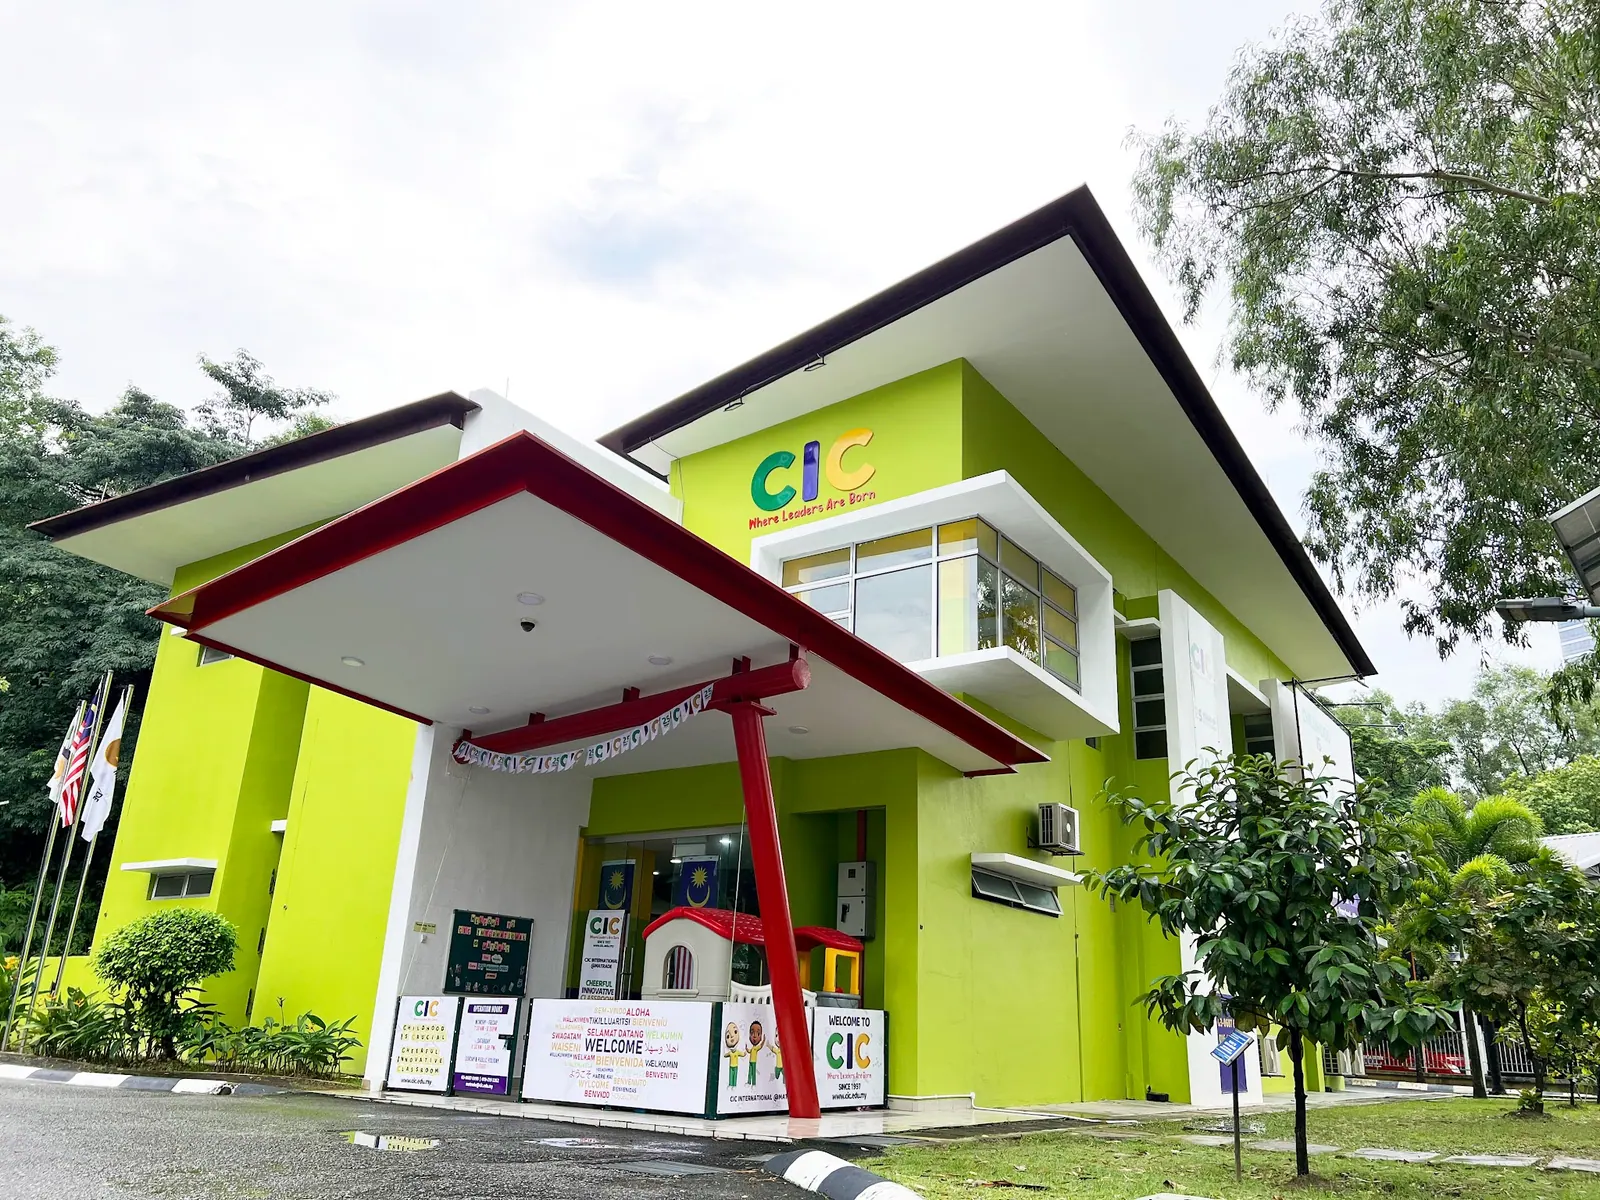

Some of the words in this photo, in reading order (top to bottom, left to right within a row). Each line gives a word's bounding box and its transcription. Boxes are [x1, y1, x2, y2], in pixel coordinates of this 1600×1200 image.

[751, 427, 876, 511] CIC
[748, 514, 780, 530] Where
[782, 504, 824, 522] Leaders
[826, 498, 846, 511] Are
[849, 491, 876, 505] Born
[589, 916, 620, 935] CIC
[585, 979, 613, 988] CHEERFUL
[581, 987, 615, 995] INNOVATIVE
[414, 1000, 440, 1017] CIC
[626, 1007, 650, 1017] ALOHA
[828, 1015, 861, 1027] WELCOME
[861, 1017, 871, 1027] TO
[402, 1024, 445, 1032] CHILDHOOD
[587, 1028, 617, 1037] SELAMAT
[618, 1029, 644, 1038] DATANG
[412, 1032, 445, 1041] CRUCIAL
[551, 1032, 582, 1040] SWAGATAM
[401, 1046, 438, 1055] CHEERFUL
[585, 1037, 644, 1055] WELCOME
[826, 1032, 871, 1070] CIC
[396, 1056, 443, 1064] INNOVATIVE
[573, 1053, 596, 1061] WELKAM
[595, 1055, 644, 1067] BIENVENIDA
[397, 1065, 440, 1074] CLASSROOM
[569, 1068, 592, 1080] ようこそ
[400, 1077, 433, 1086] www.cic.edu.my
[578, 1079, 610, 1089] WYLCOME
[838, 1083, 851, 1091] SINCE
[729, 1095, 737, 1103] CIC
[737, 1093, 773, 1102] INTERNATIONAL
[831, 1091, 868, 1100] www.cic.edu.my
